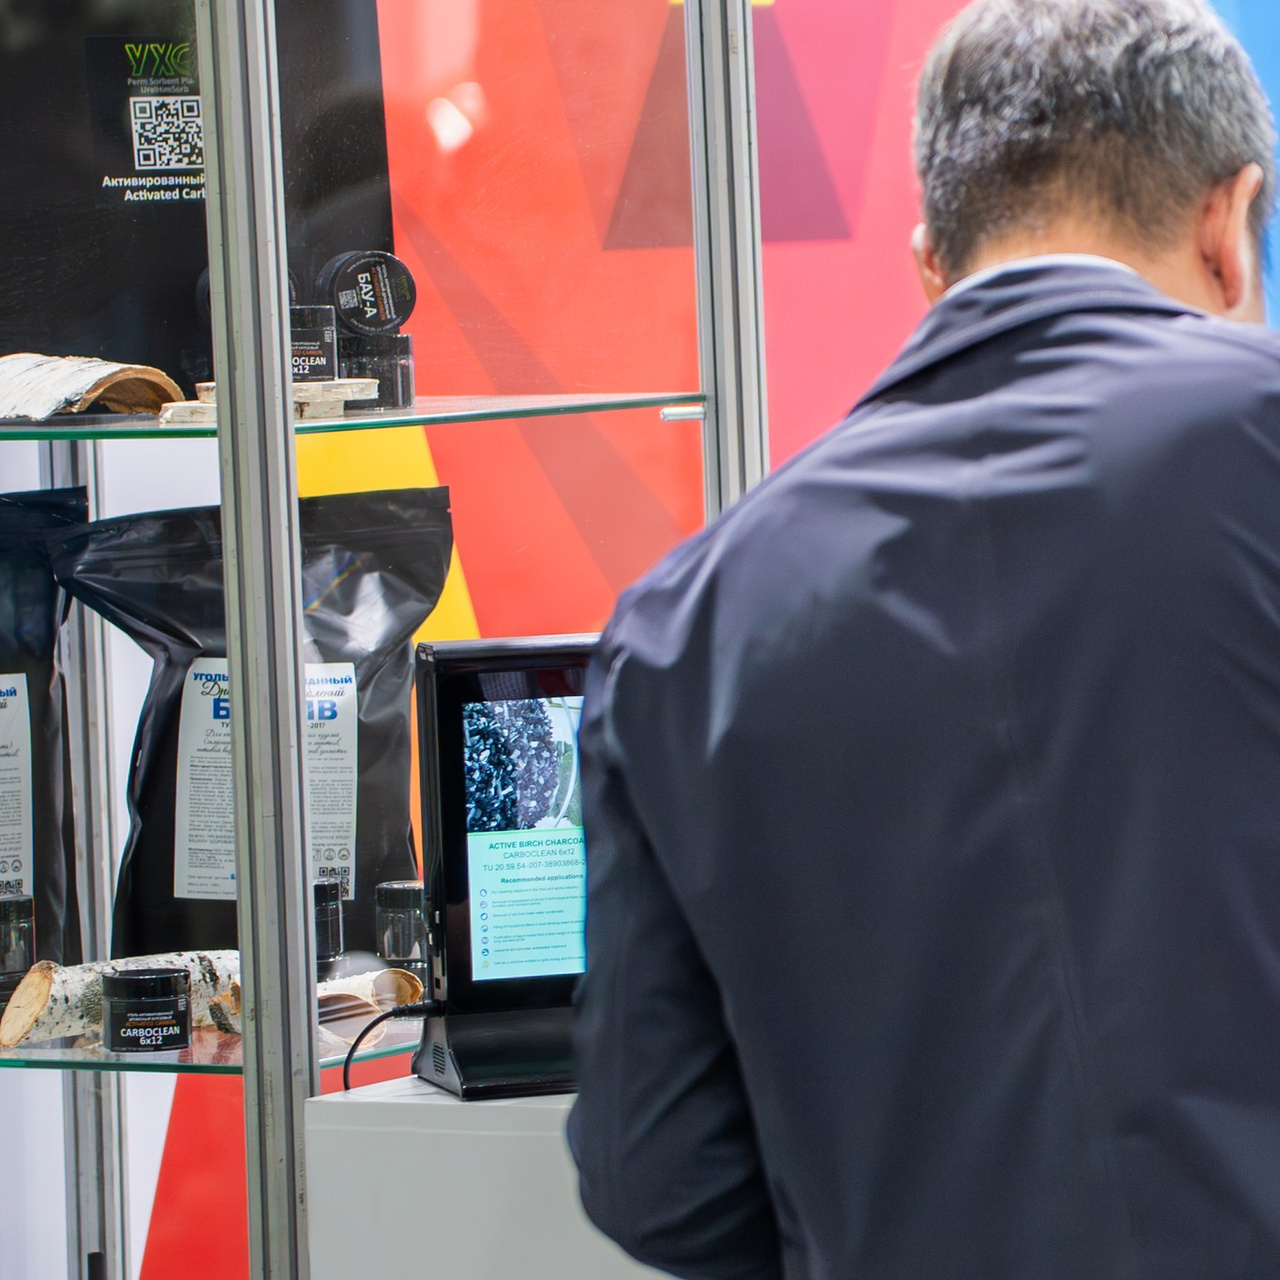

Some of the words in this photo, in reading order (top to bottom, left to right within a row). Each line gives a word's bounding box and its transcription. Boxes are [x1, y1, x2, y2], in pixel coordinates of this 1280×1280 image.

[149, 77, 180, 85] Sorbent
[181, 77, 196, 85] Pla
[124, 188, 179, 201] Activated
[357, 272, 378, 318] БАУ-А
[292, 356, 327, 365] OCLEAN
[290, 365, 310, 374] x12
[489, 841, 517, 850] ACTIVE
[519, 839, 544, 848] BIRCH
[545, 837, 584, 847] CHARCOA
[503, 849, 557, 859] CARBOCLEAN
[558, 848, 575, 856] 6x12
[483, 864, 493, 872] TU
[501, 875, 546, 884] Recommended
[547, 874, 584, 883] applications
[120, 1026, 180, 1037] CARBOCLEAN
[140, 1036, 163, 1045] 6x12
